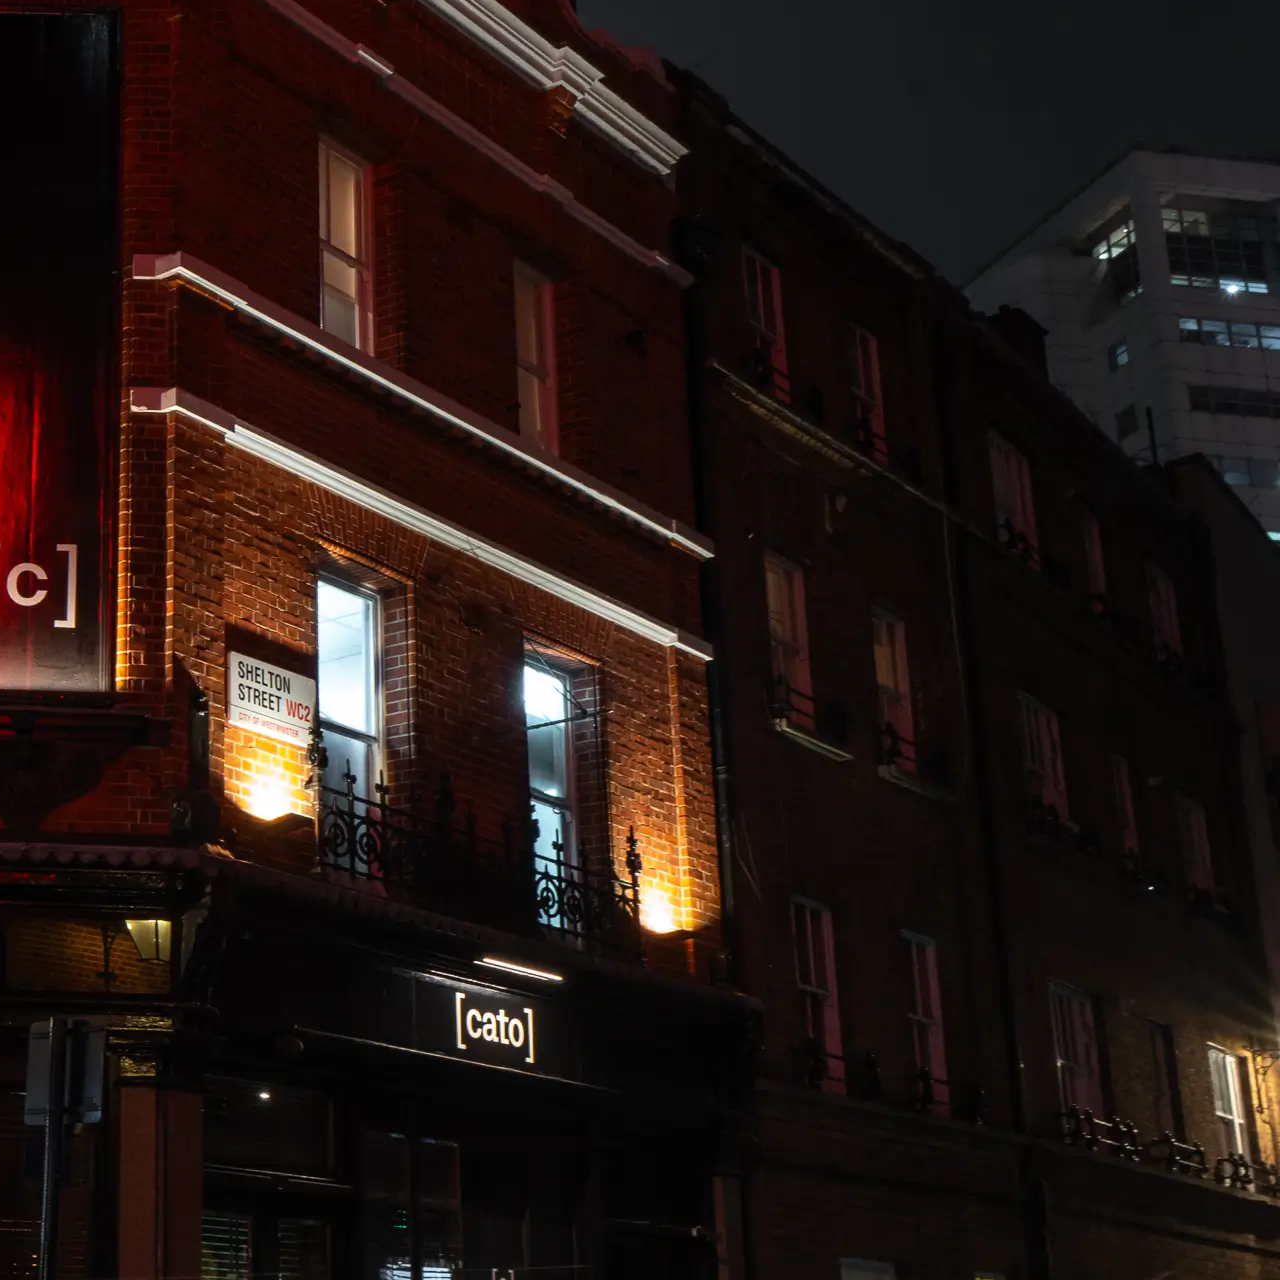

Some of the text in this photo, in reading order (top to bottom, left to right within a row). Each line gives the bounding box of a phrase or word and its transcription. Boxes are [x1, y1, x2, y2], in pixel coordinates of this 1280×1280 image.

[237, 660, 291, 695] SHELTON
[238, 683, 311, 723] STREET WC2
